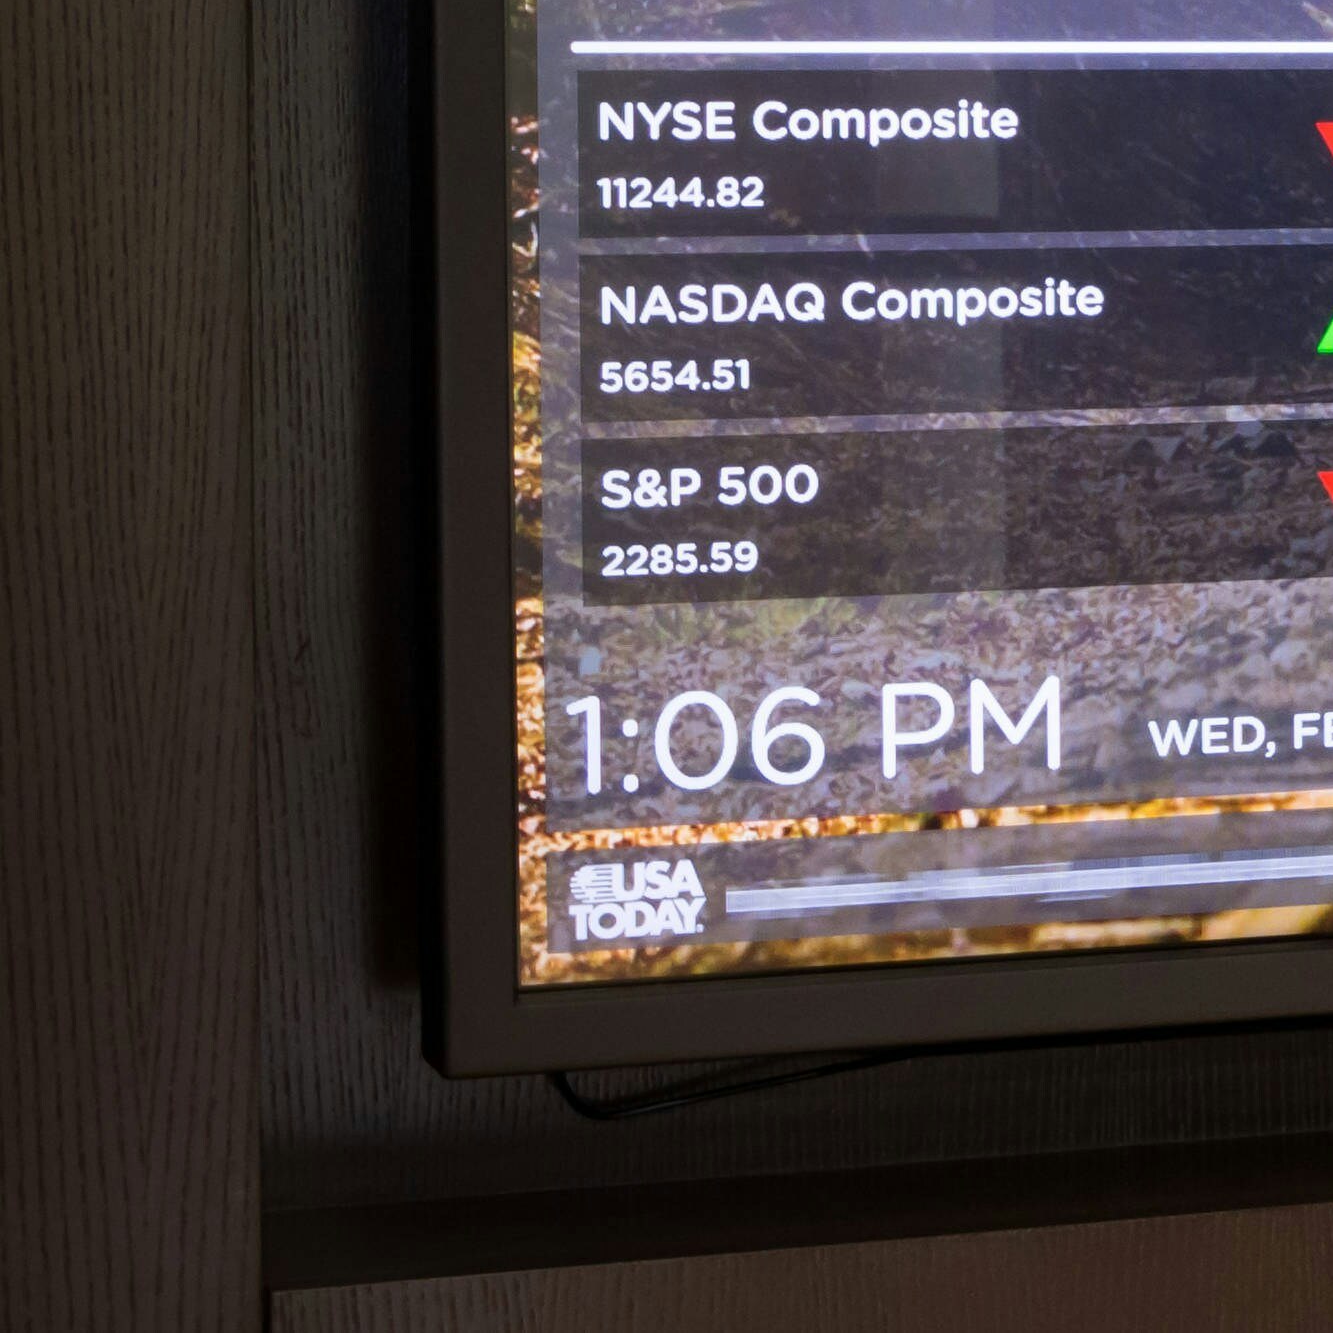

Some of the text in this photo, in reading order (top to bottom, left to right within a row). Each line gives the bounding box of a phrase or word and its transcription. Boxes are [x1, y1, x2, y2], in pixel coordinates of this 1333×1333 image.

[598, 99, 1019, 147] NYSE Composite
[597, 176, 765, 209] 11244.82
[600, 277, 1105, 326] NASDAQ Composite
[599, 359, 751, 393] 5654.51
[600, 464, 820, 509] S&P 500
[601, 541, 759, 578] 2285.59
[565, 674, 1062, 796] 1:06 PM
[1147, 716, 1277, 759] WED,
[613, 859, 703, 903] USA
